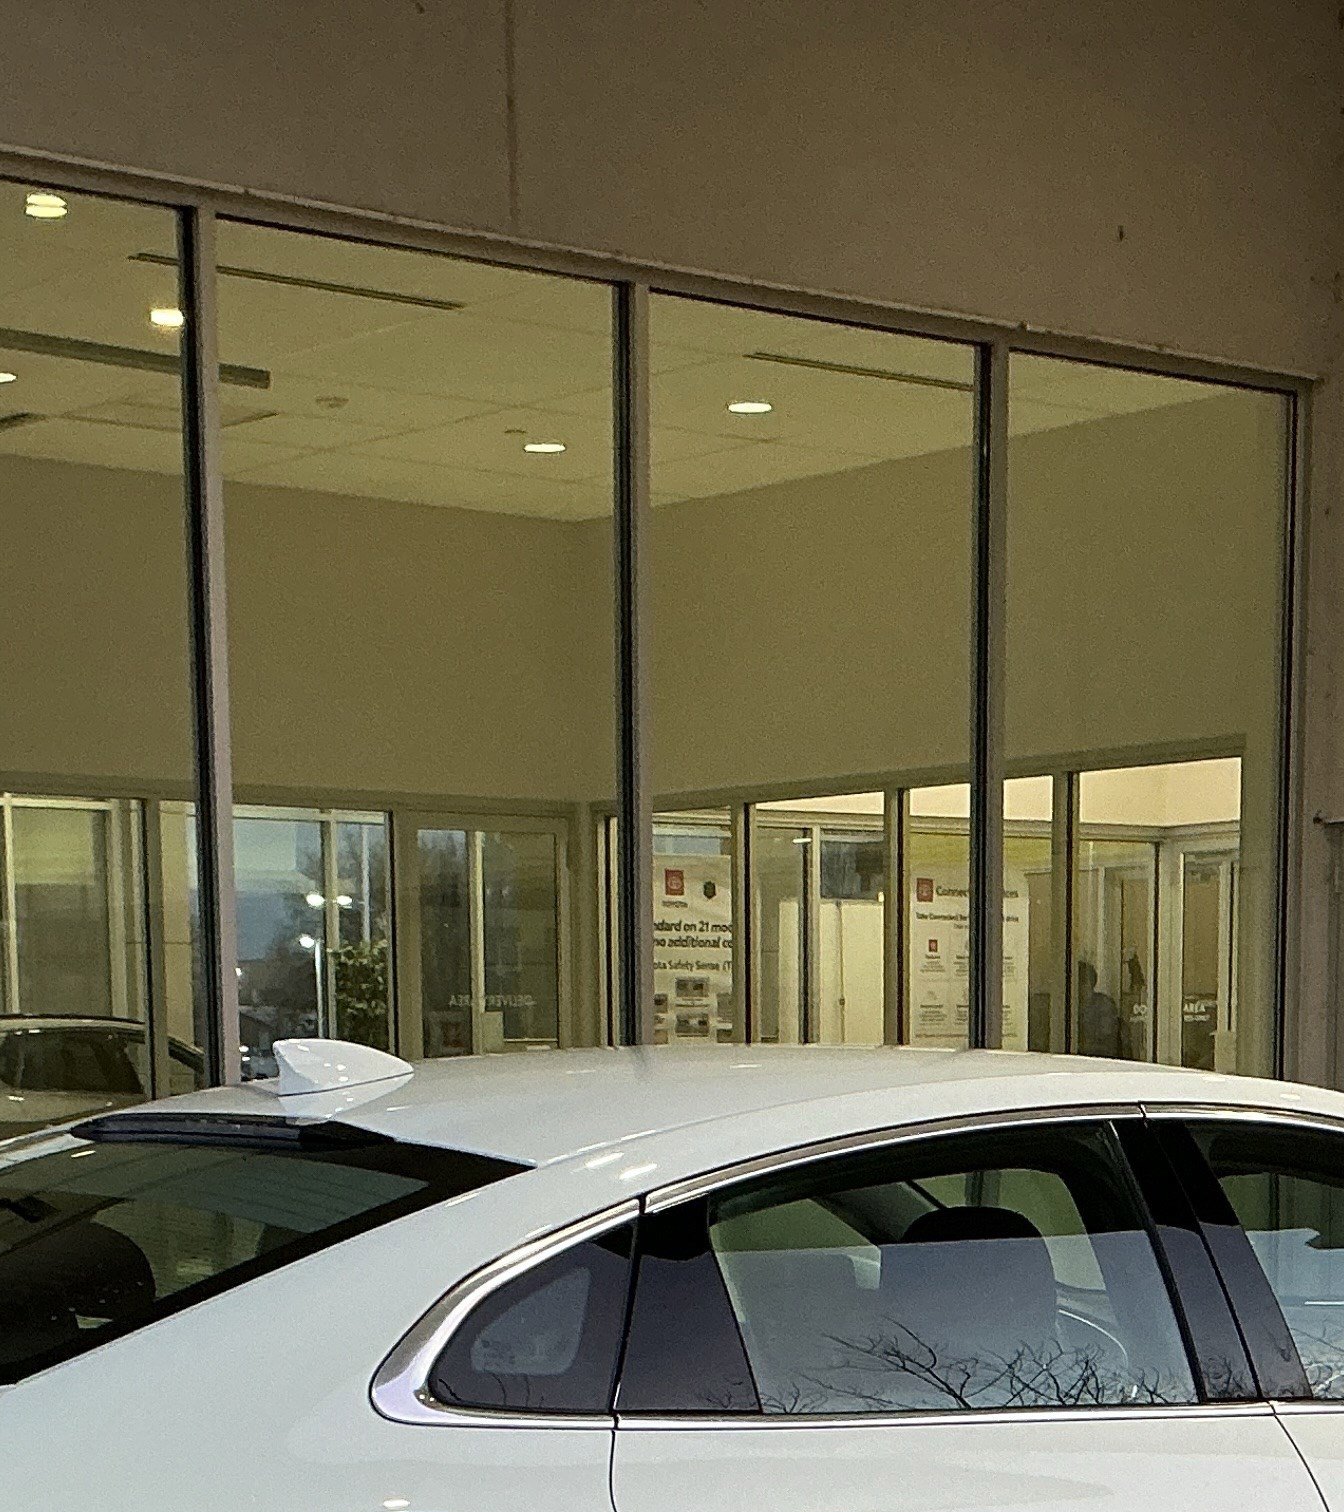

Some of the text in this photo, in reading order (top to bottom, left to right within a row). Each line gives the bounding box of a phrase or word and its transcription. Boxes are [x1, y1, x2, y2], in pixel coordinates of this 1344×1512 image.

[684, 923, 697, 932] on
[699, 920, 709, 932] 21
[668, 936, 720, 949] additional
